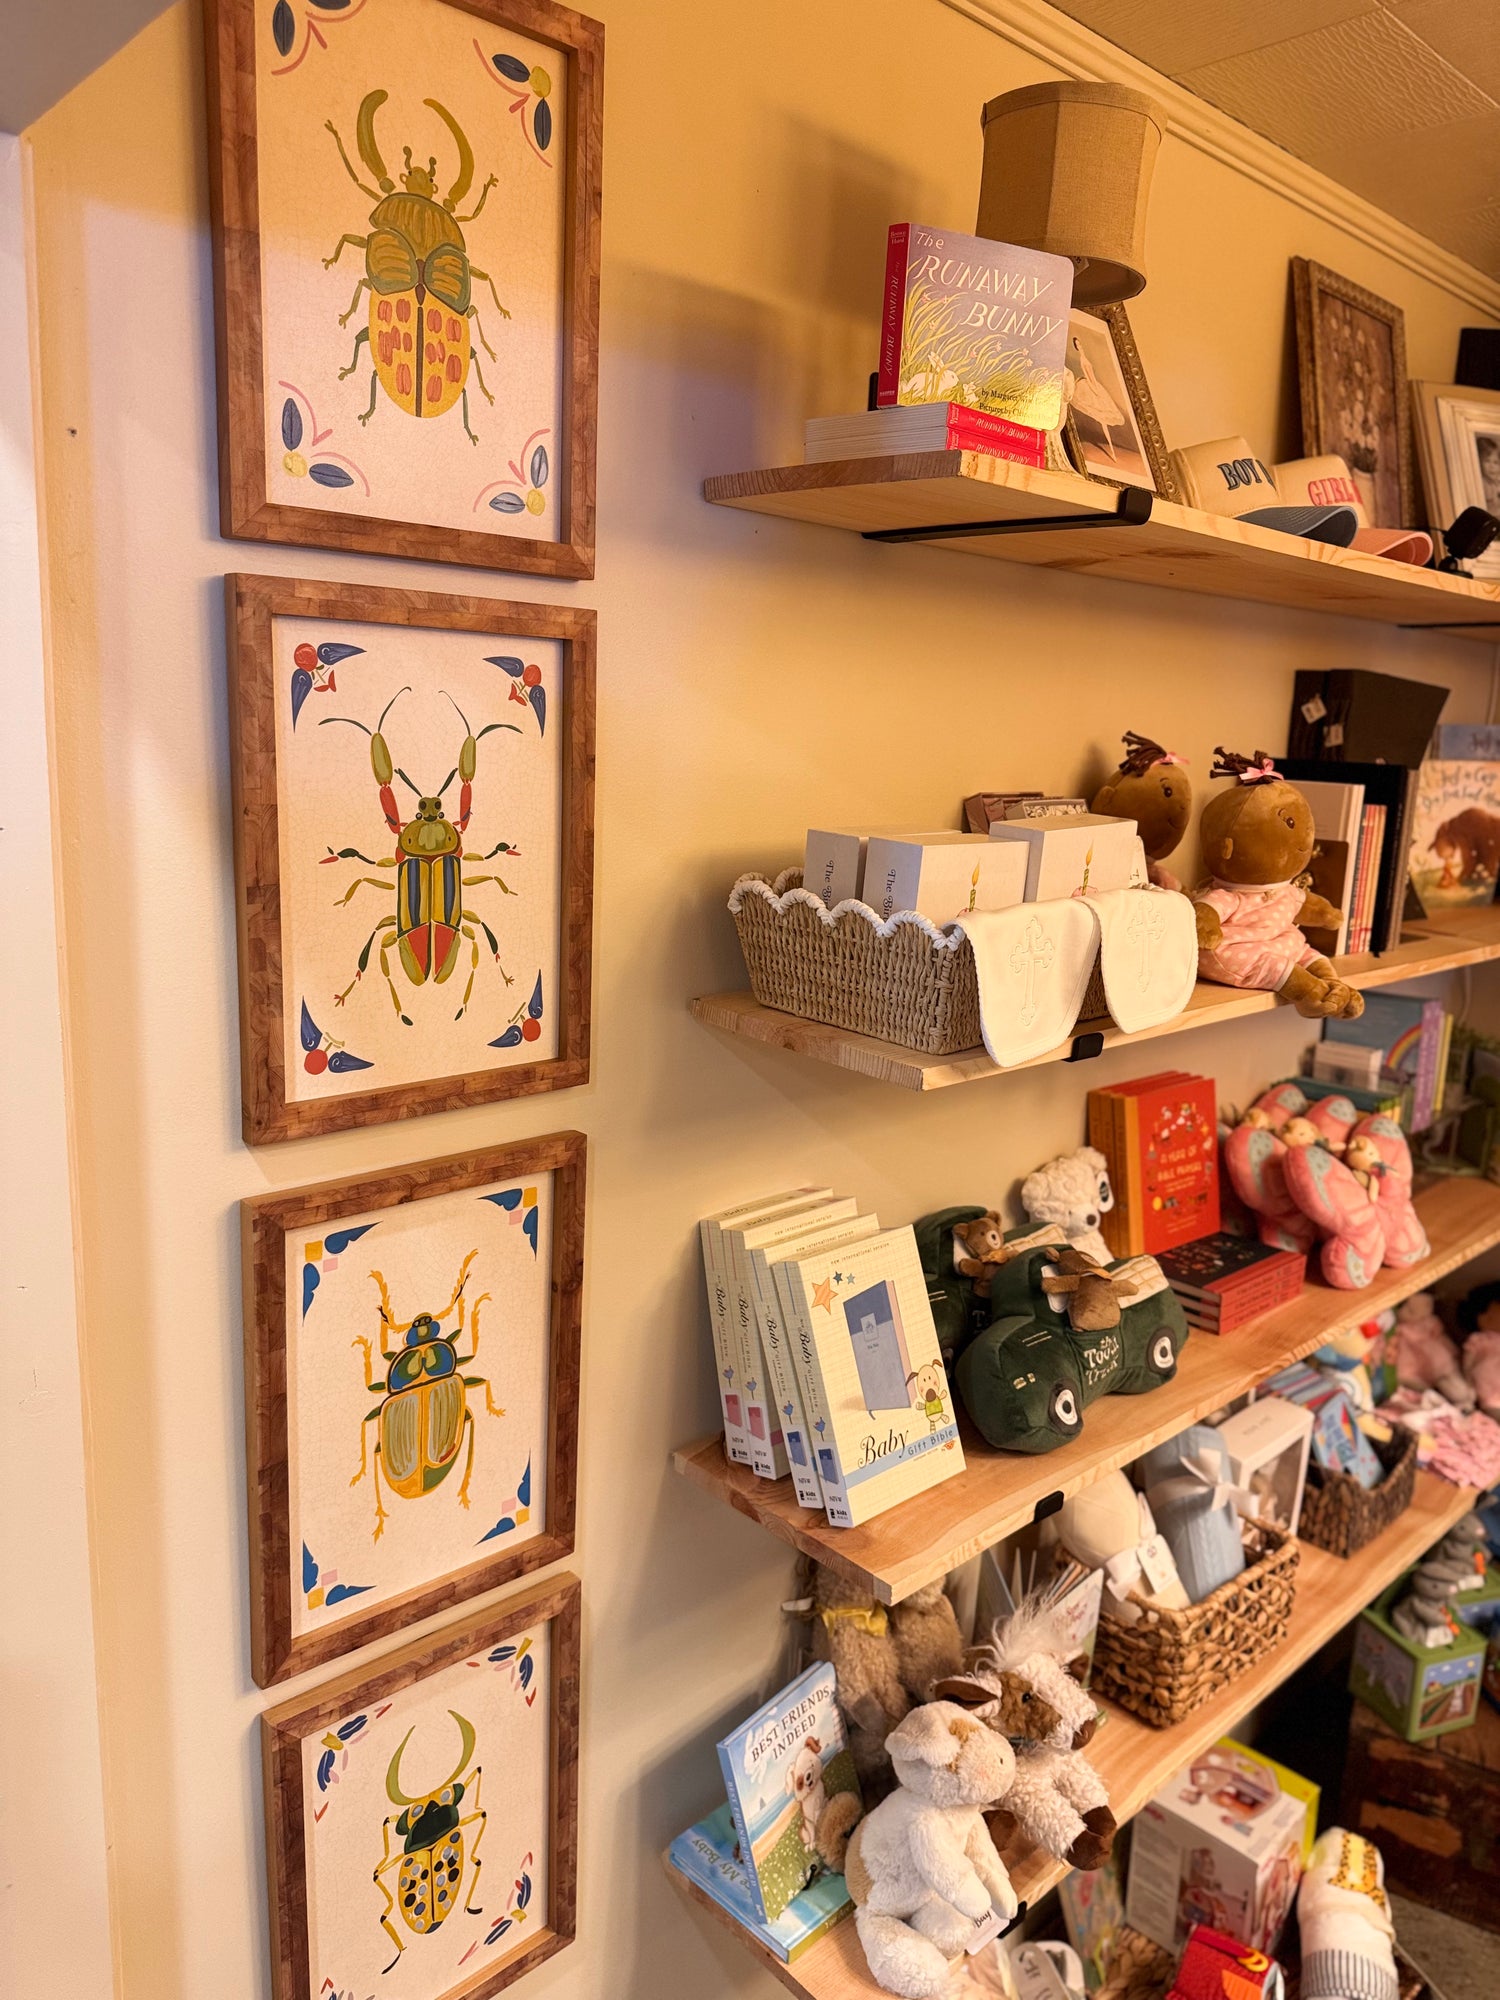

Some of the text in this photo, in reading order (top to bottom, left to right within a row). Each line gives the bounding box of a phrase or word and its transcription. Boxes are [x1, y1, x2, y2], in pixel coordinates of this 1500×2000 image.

[917, 231, 945, 250] The
[912, 254, 1055, 307] RUNAWAY
[959, 301, 1065, 346] BUNNY
[884, 334, 895, 376] BUNNY
[981, 387, 990, 401] by
[1007, 427, 1031, 442] BUNNY
[1007, 452, 1031, 465] BUNNY
[1217, 458, 1262, 491] BOY
[1307, 477, 1355, 507] GIRL
[825, 859, 834, 883] The
[885, 869, 897, 892] The
[842, 1247, 872, 1261] international
[873, 1242, 890, 1252] version
[715, 1286, 727, 1318] Baby
[738, 1294, 750, 1329] Baby
[766, 1315, 780, 1350] Baby
[799, 1328, 813, 1365] Baby
[858, 1429, 909, 1469] Baby
[907, 1440, 928, 1456] Gift
[930, 1429, 954, 1445] Bible
[751, 1685, 830, 1763] BEST FRIENDS
[772, 1713, 816, 1760] INDEED
[728, 1781, 738, 1807] BEST
[692, 1839, 741, 1882] My Baby
